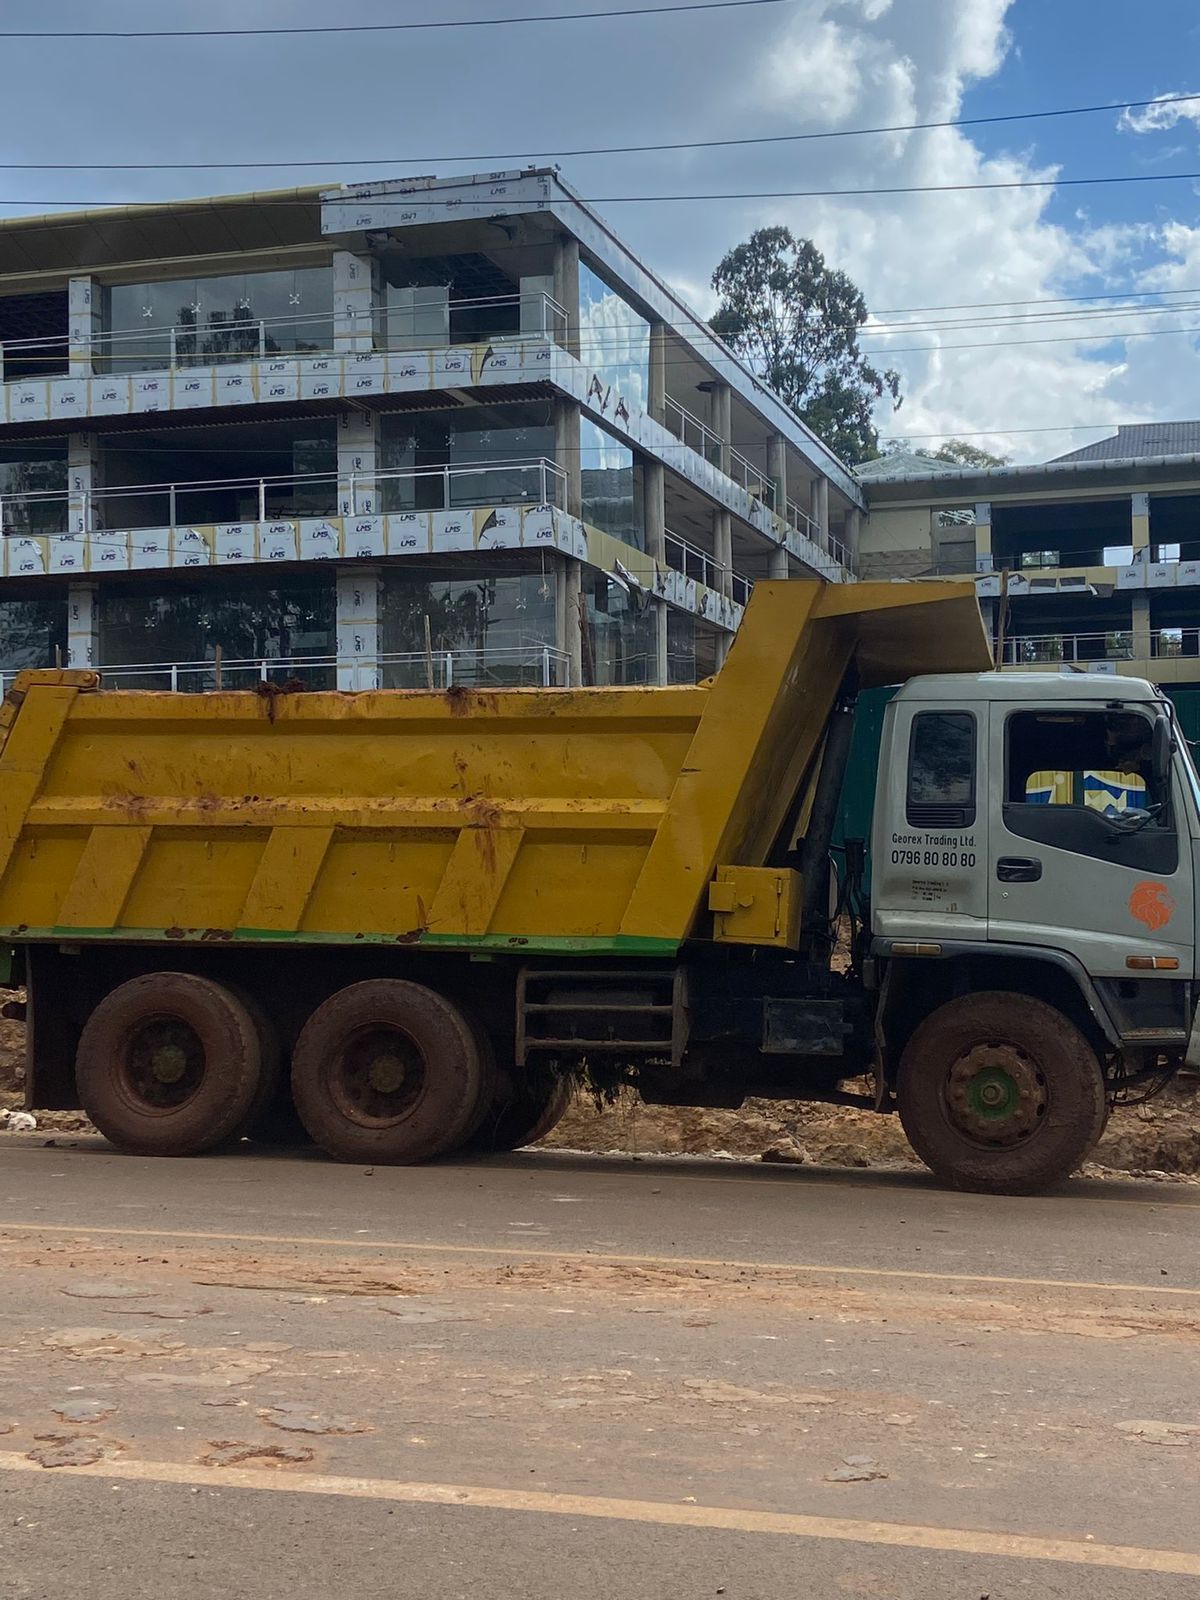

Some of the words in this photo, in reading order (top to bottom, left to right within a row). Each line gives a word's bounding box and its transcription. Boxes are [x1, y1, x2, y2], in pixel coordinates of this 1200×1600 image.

[270, 363, 285, 371] LMS
[491, 359, 507, 367] LMS
[400, 369, 416, 377] LMS
[21, 396, 35, 404] LMS
[61, 396, 75, 404] LMS
[536, 505, 552, 513] LMS
[536, 531, 552, 539] LMS
[143, 545, 158, 553] LMS
[892, 833, 922, 844] Georex
[925, 834, 958, 849] Trading
[960, 836, 977, 847] Ltd.
[891, 850, 921, 864] 0796
[924, 851, 939, 866] 80
[942, 852, 957, 867] 80
[960, 853, 976, 867] 80
